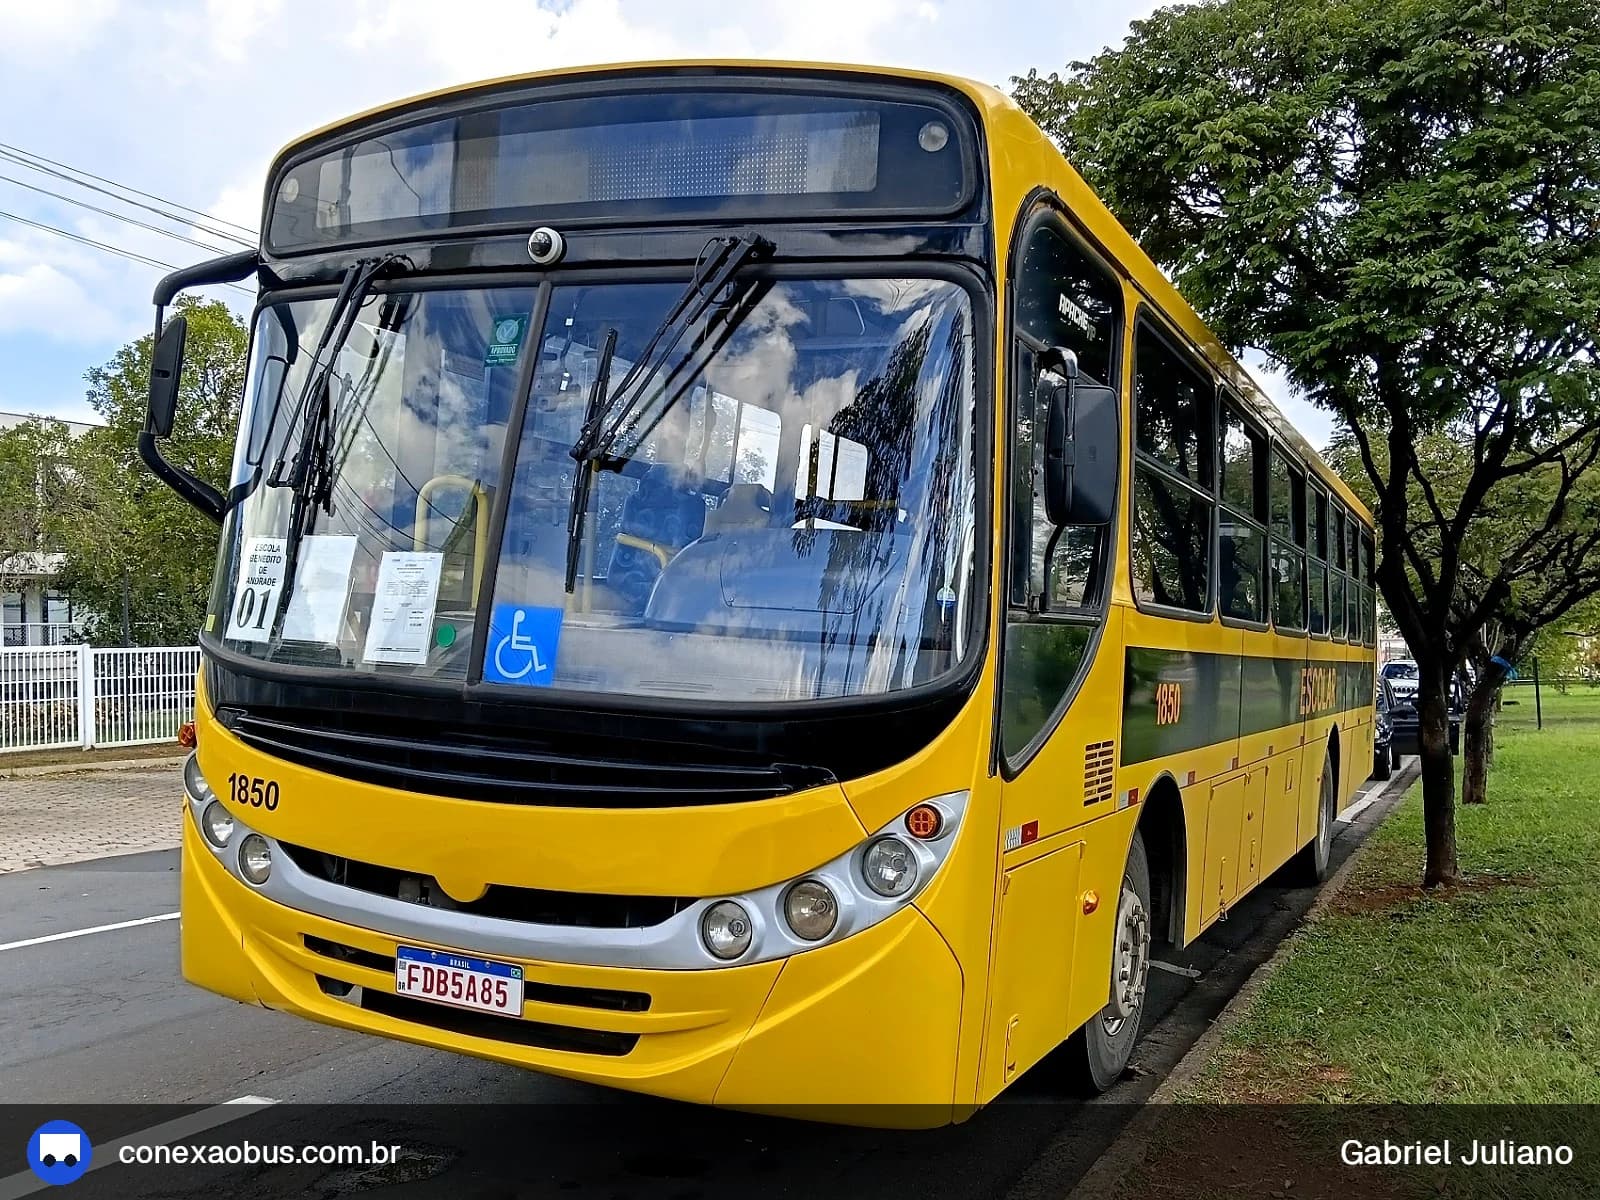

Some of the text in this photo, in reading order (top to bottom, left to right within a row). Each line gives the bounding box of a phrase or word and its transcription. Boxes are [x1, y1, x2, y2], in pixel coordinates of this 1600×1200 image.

[1059, 293, 1088, 330] APACHE
[249, 554, 282, 564] BENEDITO
[254, 543, 281, 552] ESCOLA
[246, 576, 277, 586] ANDRADE
[258, 566, 268, 574] DE
[236, 587, 271, 630] 01
[1156, 683, 1181, 725] 1850
[1299, 667, 1337, 715] ESCOLAR
[228, 772, 280, 811] 1850
[449, 959, 470, 969] BRASIL
[407, 964, 508, 1008] FDB5A85
